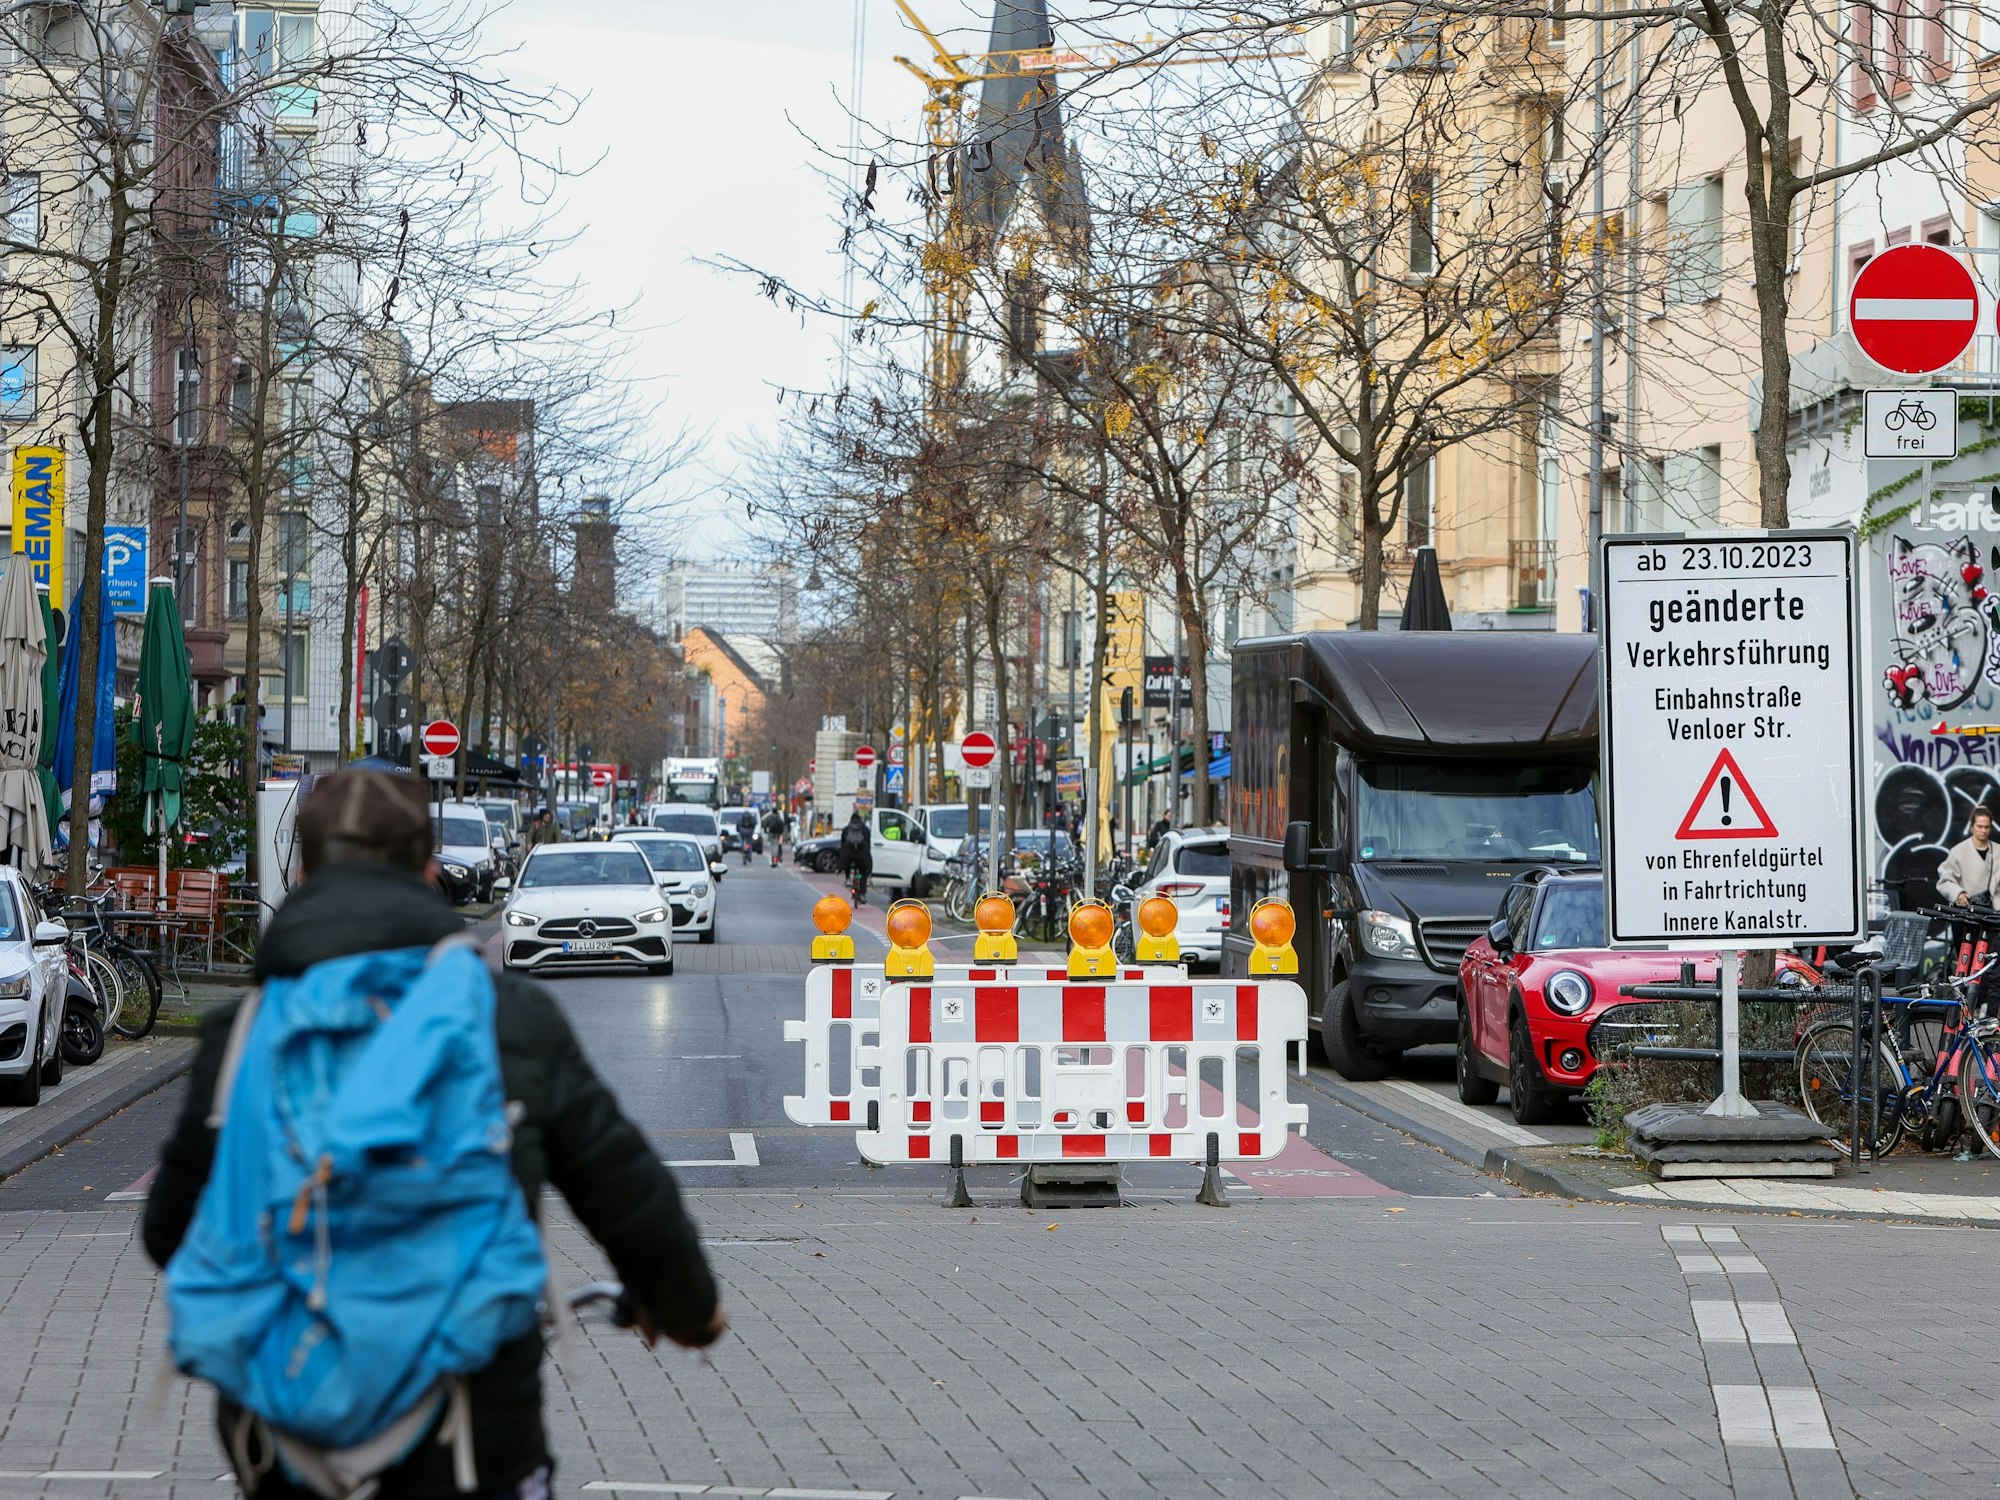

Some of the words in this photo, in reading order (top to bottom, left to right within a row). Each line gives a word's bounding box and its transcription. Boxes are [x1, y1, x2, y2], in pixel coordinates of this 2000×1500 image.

[1896, 435, 1925, 450] frei
[25, 456, 52, 585] EEMAN
[1637, 548, 1667, 572] ab
[1682, 544, 1812, 570] 23.10.2023
[1650, 587, 1804, 633] geänderte
[1627, 638, 1830, 670] Verkehrsführung
[1655, 685, 1802, 711] Einbahnstraße
[1668, 717, 1746, 741] Venloer
[1754, 716, 1791, 738] Str.
[1645, 855, 1677, 870] von
[1683, 847, 1823, 872] Ehrenfeldgürtel
[1663, 881, 1678, 900] in
[1684, 879, 1807, 903] Fahrtrichtung
[1664, 912, 1719, 931] Innere
[1725, 909, 1807, 930] Kanalstr.
